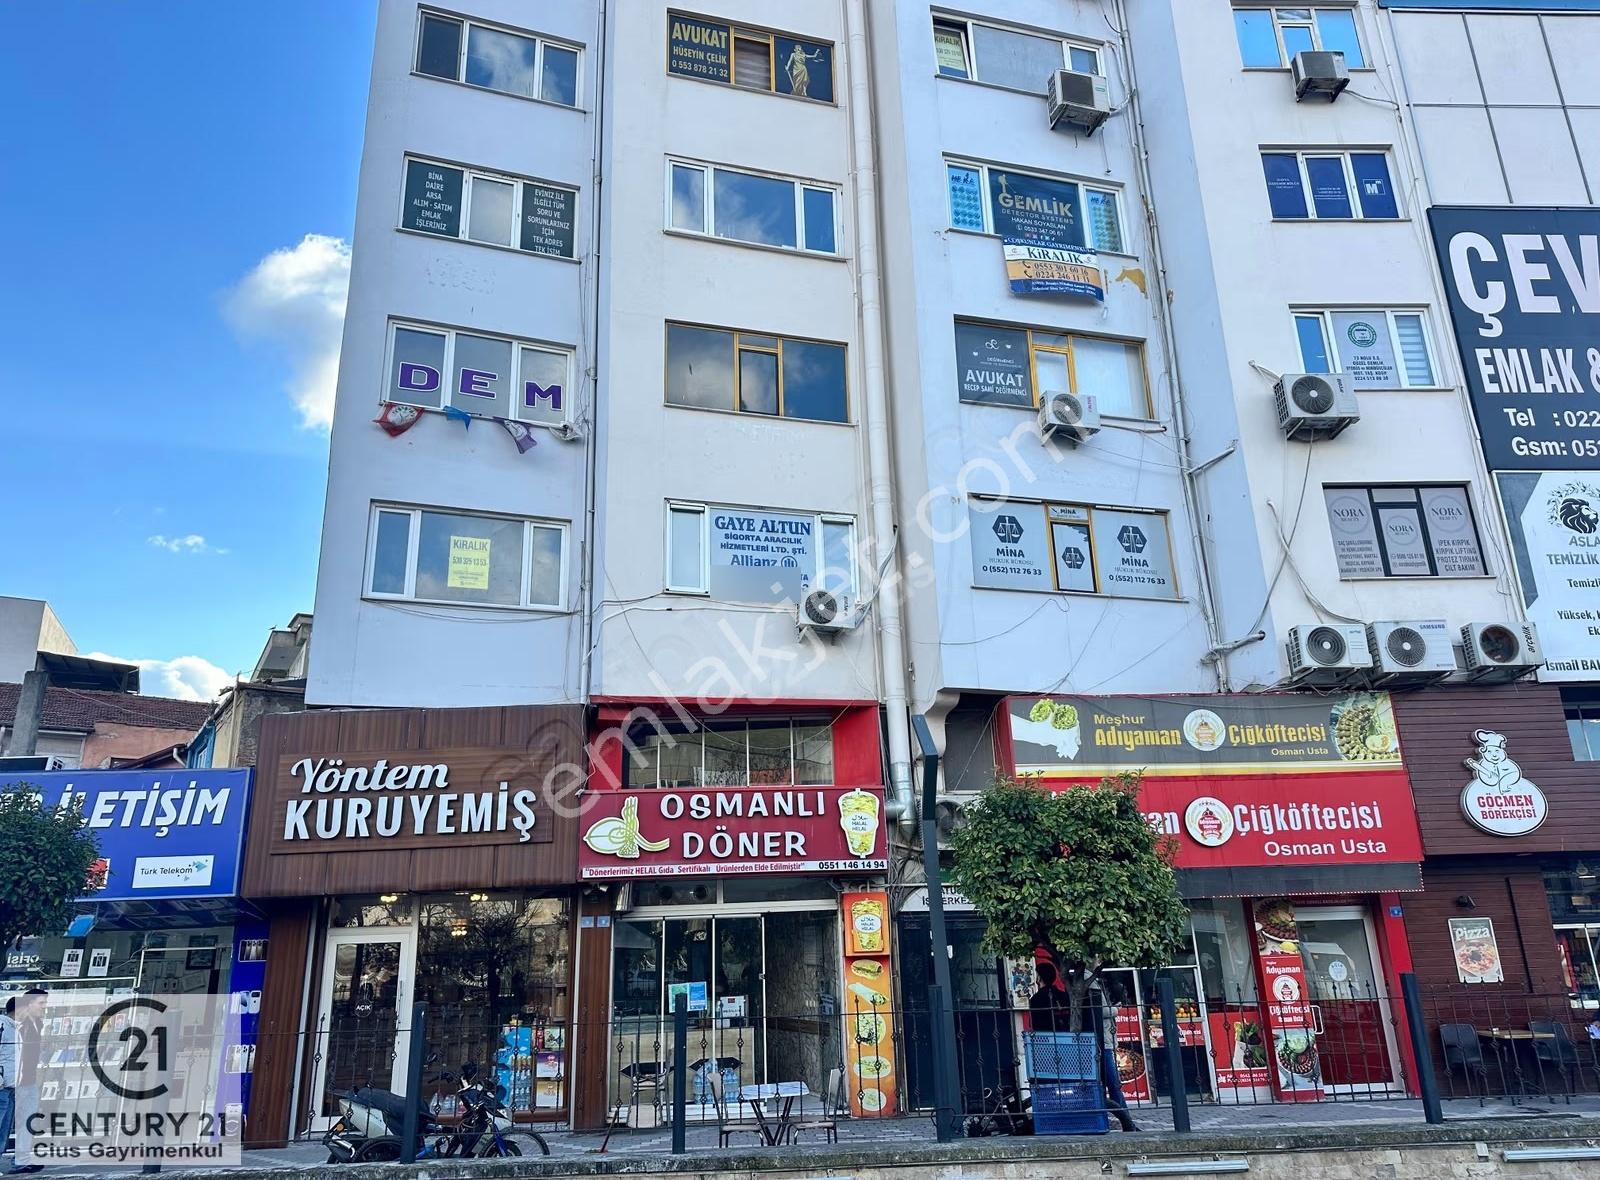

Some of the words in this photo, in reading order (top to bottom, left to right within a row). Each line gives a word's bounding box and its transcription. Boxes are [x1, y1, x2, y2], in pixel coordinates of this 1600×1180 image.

[672, 22, 728, 49] AVUKAT
[672, 45, 704, 60] HÜSEYİN
[706, 52, 727, 65] ÇELİK
[679, 62, 692, 70] 553
[693, 64, 707, 74] 878
[708, 66, 718, 76] 21
[719, 68, 728, 78] 32
[428, 172, 444, 182] BİNA
[426, 181, 444, 192] DAİRE
[426, 191, 442, 200] ARSA
[434, 202, 452, 213] SATIM
[552, 200, 564, 210] TÜM
[998, 192, 1074, 218] GEMLİK
[422, 210, 442, 220] EMLAK
[536, 208, 552, 216] SORU
[553, 210, 560, 218] VE
[1002, 208, 1040, 219] DETECTOR
[1042, 214, 1074, 225] SYSTEMS
[1012, 216, 1032, 226] HAKAN
[533, 236, 546, 244] TEK
[546, 237, 563, 248] ADRES
[1036, 270, 1054, 278] 0224
[1448, 232, 1600, 338] ÇEV
[966, 369, 1024, 386] AVUKAT
[1475, 348, 1584, 394] EMLAK
[964, 384, 980, 392] RECEP
[1504, 408, 1536, 427] Tel
[1512, 436, 1567, 456] Gsm:
[1572, 440, 1600, 456] 05
[1333, 508, 1364, 518] NORA
[1431, 507, 1462, 516] NORA
[714, 516, 756, 532] GAYE
[758, 519, 812, 536] ALTUN
[724, 532, 762, 542] SİGORTA
[763, 536, 802, 544] ARACILIK
[720, 542, 769, 552] HİZMETLERİ
[792, 547, 807, 556] ŞTİ.
[996, 546, 1025, 558] MİNA
[730, 554, 778, 567] Allianz
[1121, 556, 1149, 568] MİNA
[1546, 551, 1600, 566] TEMİZLİK
[988, 565, 1008, 574] (552)
[1115, 574, 1134, 584] (552)
[1557, 610, 1596, 620] Yüksek,
[1522, 625, 1536, 654] arçelik
[1544, 656, 1578, 672] İsmail
[1094, 714, 1145, 726] Meşhur
[1095, 728, 1182, 750] Adıyaman
[1228, 724, 1326, 746] Çiğköftecisi
[1271, 748, 1306, 756] Osman
[1307, 747, 1328, 756] Usta
[290, 758, 449, 794] Yöntem
[660, 791, 825, 820] OSMANLI
[1477, 793, 1534, 810] GÖÇMEN
[283, 782, 536, 842] KURUYEMİŞ
[1232, 801, 1382, 836] Çiğköftecisi
[1481, 807, 1537, 820] BÖREKÇİSİ
[683, 825, 807, 858] DÖNER
[1264, 841, 1335, 857] Osman
[1340, 839, 1386, 855] Usta
[140, 867, 157, 875] Türk
[160, 866, 193, 875] Telekom
[635, 867, 658, 875] HELAL
[678, 865, 710, 874] Sertifikalı
[716, 863, 753, 872] Ürünlerden
[754, 864, 768, 872] Elde
[818, 862, 839, 870] 0551
[874, 860, 885, 868] 94
[1454, 926, 1490, 940] Pizza
[355, 1004, 372, 1012] AÇIK
